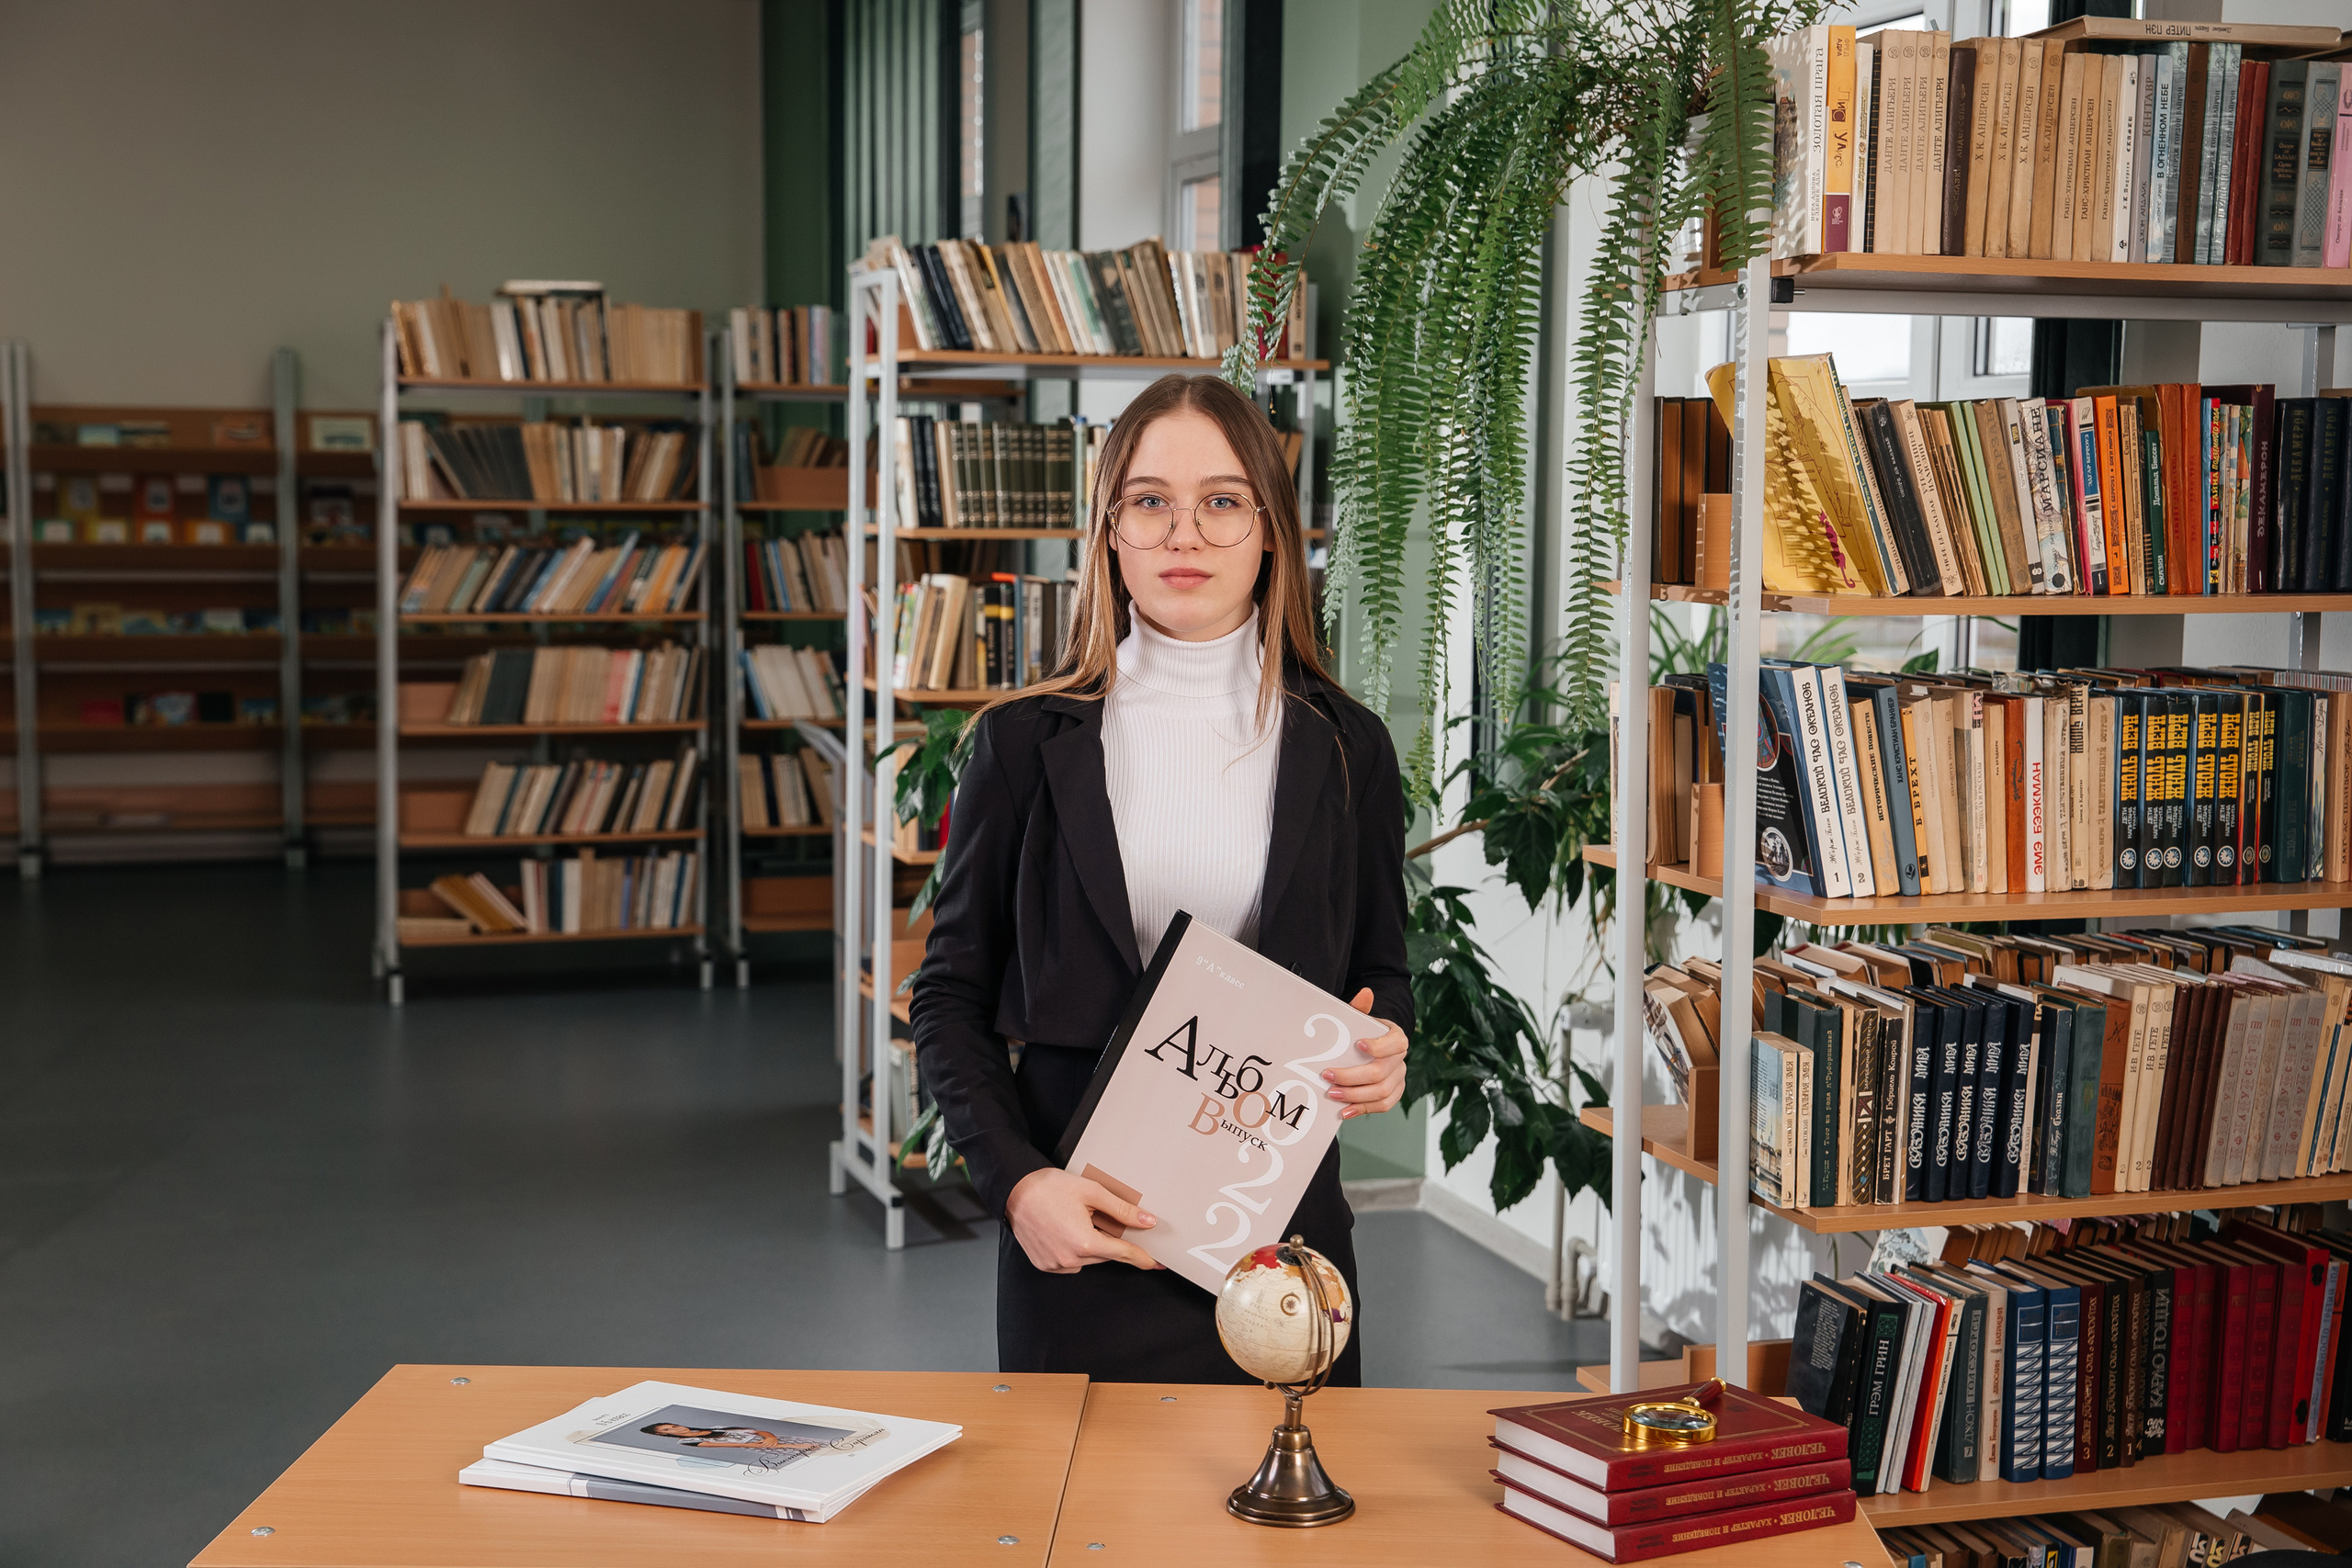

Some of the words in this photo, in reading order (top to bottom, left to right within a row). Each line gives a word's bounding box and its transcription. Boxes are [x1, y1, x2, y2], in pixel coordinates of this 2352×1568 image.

[2145, 24, 2163, 36] ПЭН
[2165, 24, 2191, 37] ПИТЕР
[1886, 77, 1896, 135] АЛИГЬЕРИ
[1902, 77, 1911, 135] АЛИГЬЕРИ
[1918, 76, 1928, 135] АЛИГЬЕРИ
[1935, 77, 1944, 134] АЛИГЬЕРИ
[1977, 83, 1990, 138] АНДЕРСЕН
[2000, 83, 2012, 138] АНДЕРСЕН
[2022, 86, 2034, 141] АНДЕРСЕН
[2044, 85, 2055, 140] АНДЕРСЕН
[2143, 76, 2154, 137] КЕНТАВР
[1884, 137, 1893, 174] ДАНТЕ
[1899, 137, 1908, 173] ДАНТЕ
[1917, 136, 1925, 172] ДАНТЕ
[1934, 135, 1942, 172] ДАНТЕ
[2081, 149, 2091, 220] ГАНС-ХРИСТИАН
[2086, 98, 2094, 146] АНДЕРСЕН
[2158, 114, 2167, 169] ОГНЕННОМ
[2064, 149, 2074, 219] ГАНС-ХРИСТИАН
[2102, 150, 2111, 220] ГАНС-ХРИСТИАН
[1847, 428, 1860, 466] Сказки
[1986, 407, 2007, 484] ТАРЗАН
[2290, 410, 2304, 481] ДЕКАМЕРОН
[2324, 408, 2337, 479] ДЕКАМЕРОН
[2031, 407, 2052, 516] МАРСИАНЕ
[2257, 441, 2268, 537] ДЕКАМЕРОН
[1802, 682, 1818, 735] ОКЕАНОВ
[1829, 684, 1844, 737] ОКЕАНОВ
[1888, 697, 1897, 729] БРАННЕР
[2070, 689, 2083, 716] ВЕРН
[1865, 712, 1873, 750] ПОВЕСТИ
[2070, 720, 2083, 753] ЖЮЛЬ
[2122, 714, 2139, 750] ВЕРН
[2147, 715, 2165, 750] ВЕРН
[2167, 714, 2188, 749] ВЕРН
[2198, 714, 2217, 749] ВЕРН
[2221, 714, 2240, 748] ВЕРН
[2248, 712, 2259, 736] ВЕРН
[2264, 710, 2275, 735] ВЕРН
[1811, 739, 1821, 762] ЧАС
[1837, 740, 1848, 764] ЧАС
[1892, 730, 1902, 764] КРИСТИАН
[2247, 740, 2258, 772] ЖЮЛЬ
[2263, 739, 2274, 771] ЖЮЛЬ
[1813, 765, 1830, 814] ВЕЛИКИЙ
[1839, 766, 1856, 815] ВЕЛИКИЙ
[1870, 753, 1883, 821] ИСТОРИЧЕСКИЕ
[1909, 757, 1921, 809] БРЕХТ
[2120, 755, 2138, 801] ЖЮЛЬ
[2145, 755, 2165, 801] ЖЮЛЬ
[2165, 754, 2186, 800] ЖЮЛЬ
[2196, 754, 2215, 798] ЖЮЛЬ
[2219, 754, 2238, 798] ЖЮЛЬ
[2032, 762, 2042, 834] БЭЭКМАН
[1917, 816, 1922, 826] Б.
[1829, 840, 1838, 863] Жорж
[1854, 840, 1863, 865] Жорж
[2033, 841, 2042, 875] ЭМЭ
[1858, 873, 1865, 883] 2
[1219, 968, 1245, 990] класс
[1888, 1040, 1897, 1071] Конрой
[2132, 1030, 2142, 1053] ГЕТЕ
[2149, 1027, 2158, 1050] ГЕТЕ
[2161, 1026, 2170, 1050] ГЕТЕ
[1145, 1015, 1309, 1131] Альбом
[1785, 1061, 1793, 1079] ЗМЕЯ
[1914, 1046, 1929, 1078] МИРА
[1963, 1043, 1977, 1075] МИРА
[1985, 1041, 2001, 1073] МИРА
[1885, 1074, 1894, 1111] Гэбриель
[1936, 1091, 1952, 1168] СКАЗОЧНИКИ
[1944, 1042, 1957, 1074] МИРА
[2007, 1089, 2025, 1164] СКАЗОЧНИКИ
[2017, 1043, 2030, 1076] МИРА
[2053, 1092, 2063, 1126] Сказки
[1187, 1093, 1268, 1152] Выпуск
[1908, 1093, 1927, 1168] СКАЗОЧНИКИ
[1956, 1085, 1973, 1161] СКАЗОЧНИКИ
[1977, 1088, 1996, 1163] СКАЗОЧНИКИ
[1884, 1130, 1893, 1154] ГАРТ
[1883, 1158, 1891, 1180] БРЕТ
[2120, 1164, 2125, 1174] 2
[2136, 1161, 2142, 1170] 2
[2147, 1160, 2152, 1169] 2
[2153, 1288, 2169, 1350] ГОЦЦИ
[1875, 1340, 1889, 1375] ГРИН
[1967, 1312, 1981, 1401] ГОЛСУОРСИ
[1939, 1365, 1948, 1394] Короли
[2150, 1353, 2165, 1408] КАРЛО
[1869, 1381, 1883, 1415] ГРЭМ
[1963, 1404, 1975, 1444] ДЖОН
[1664, 1457, 1713, 1473] ПОВЕДЕНИЕ
[1714, 1457, 1721, 1466] И
[1724, 1452, 1765, 1467] ХАРАКТЕР
[1770, 1442, 1826, 1461] ЧЕЛОВЕК
[2084, 1448, 2090, 1460] 3
[2108, 1445, 2113, 1457] 2
[2128, 1443, 2132, 1455] 1
[1665, 1490, 1714, 1506] ПОВЕДЕНИЕ
[1716, 1489, 1723, 1498] И
[1724, 1483, 1765, 1497] ХАРАКТЕР
[1773, 1473, 1831, 1492] ЧЕЛОВЕК
[1723, 1524, 1729, 1534] И
[1731, 1517, 1772, 1533] ХАРАКТЕР
[1780, 1506, 1836, 1526] ЧЕЛОВЕК
[1672, 1526, 1721, 1542] ПОВЕДЕНИЕ
